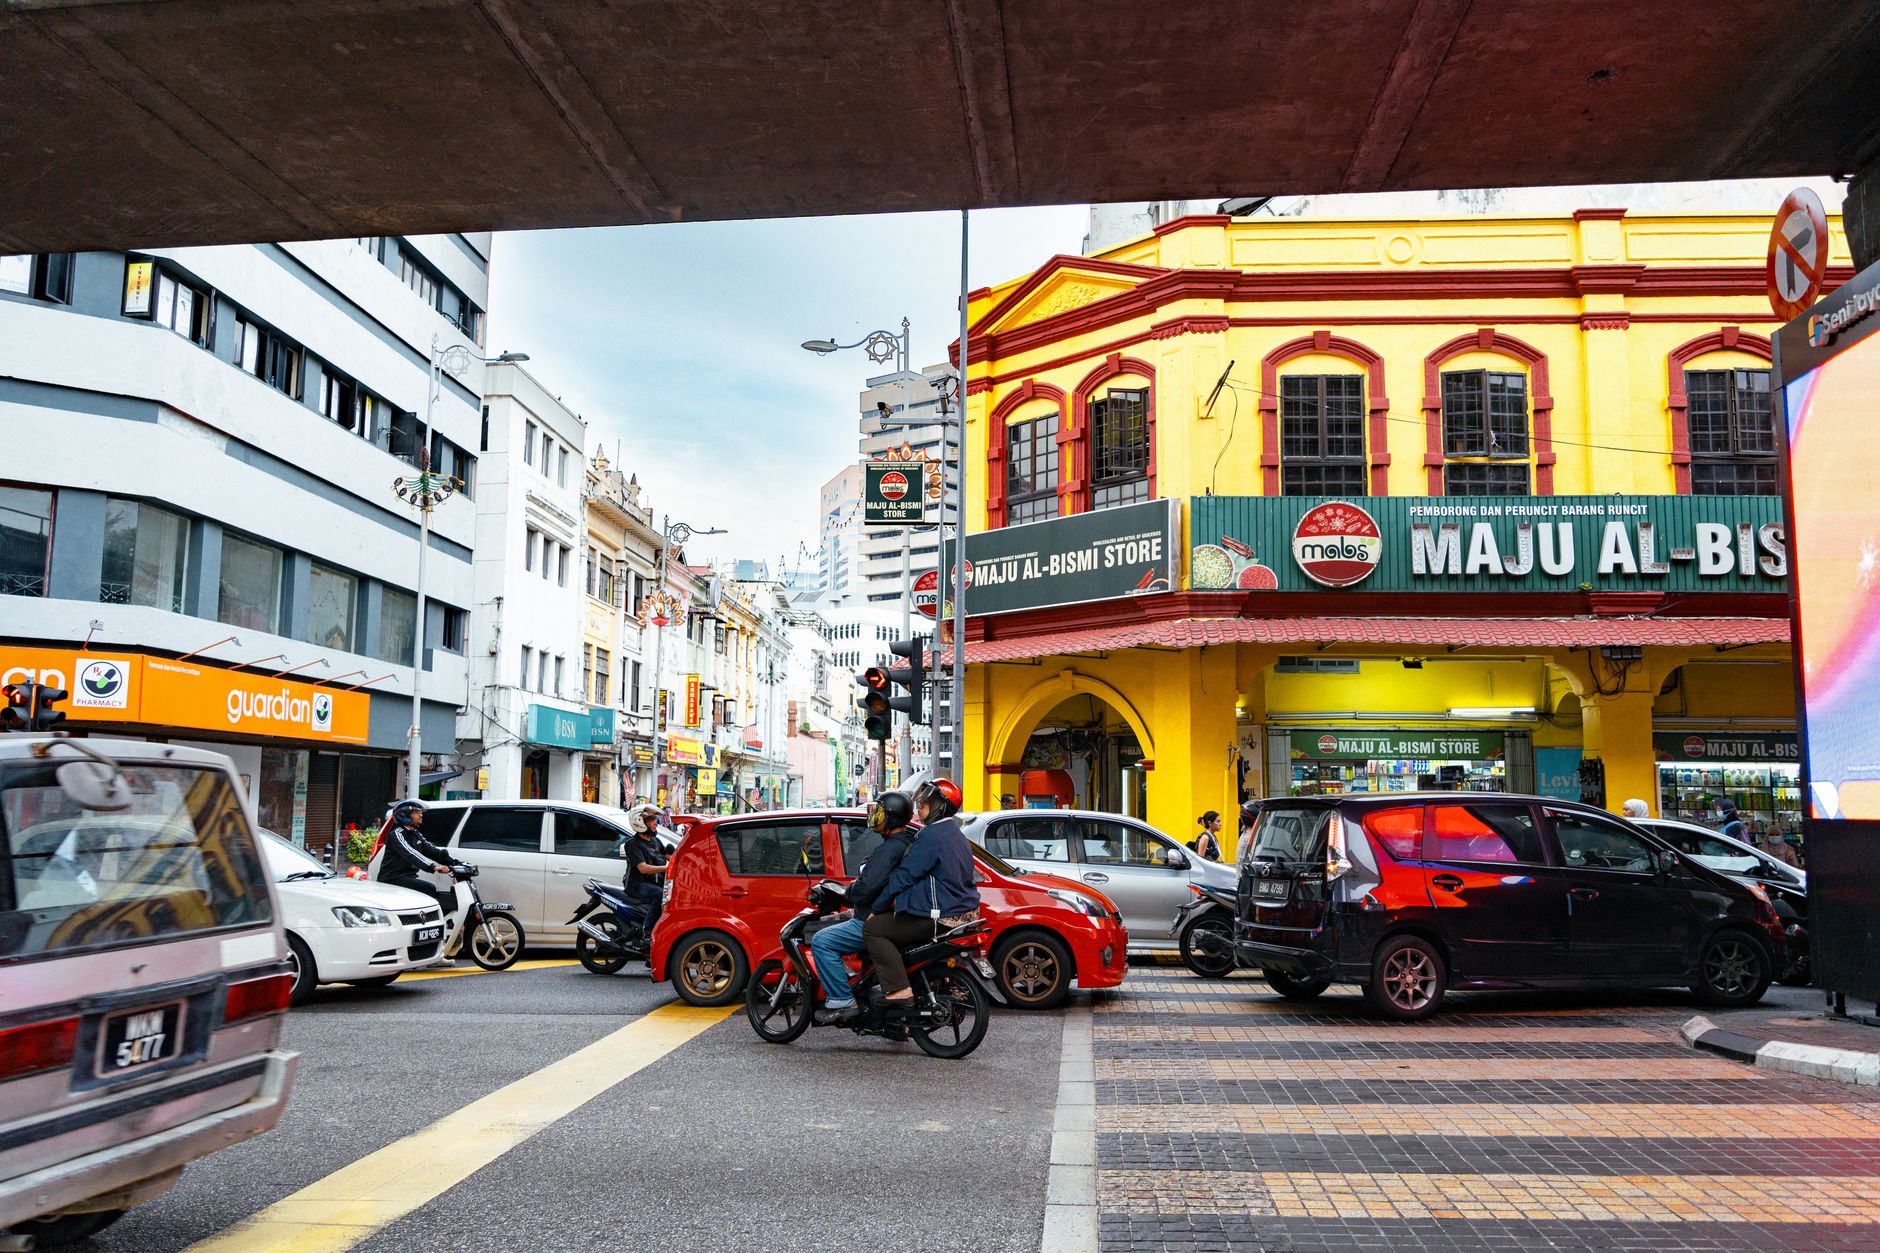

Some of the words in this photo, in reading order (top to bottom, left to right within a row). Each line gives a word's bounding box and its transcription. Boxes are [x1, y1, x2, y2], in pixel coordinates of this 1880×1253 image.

[866, 501, 887, 510] MAJU
[888, 501, 922, 510] AL-BISMI
[1409, 506, 1477, 517] PEMBORONG
[1480, 505, 1501, 516] DAN
[1505, 505, 1558, 516] PERUNCIT
[1561, 505, 1605, 516] BARANG
[1608, 504, 1648, 515] RUNCIT
[883, 510, 907, 518] STORE
[1301, 536, 1369, 562] mabs
[1410, 522, 1575, 576] MAJU
[1597, 521, 1787, 577] AL-BIS
[975, 561, 1018, 587] MAJU
[1022, 547, 1098, 580] AL-BISMI
[1104, 538, 1162, 568] STORE
[76, 698, 123, 707] PHARMACY
[227, 688, 310, 724] guardian
[561, 719, 577, 739] BSN
[591, 728, 610, 736] BSN
[1338, 741, 1374, 754] MAJU
[1378, 741, 1436, 754] AL-BISMI
[1439, 741, 1480, 755] STORE
[1707, 743, 1747, 757] MAJU
[1751, 743, 1799, 757] AL-BIS
